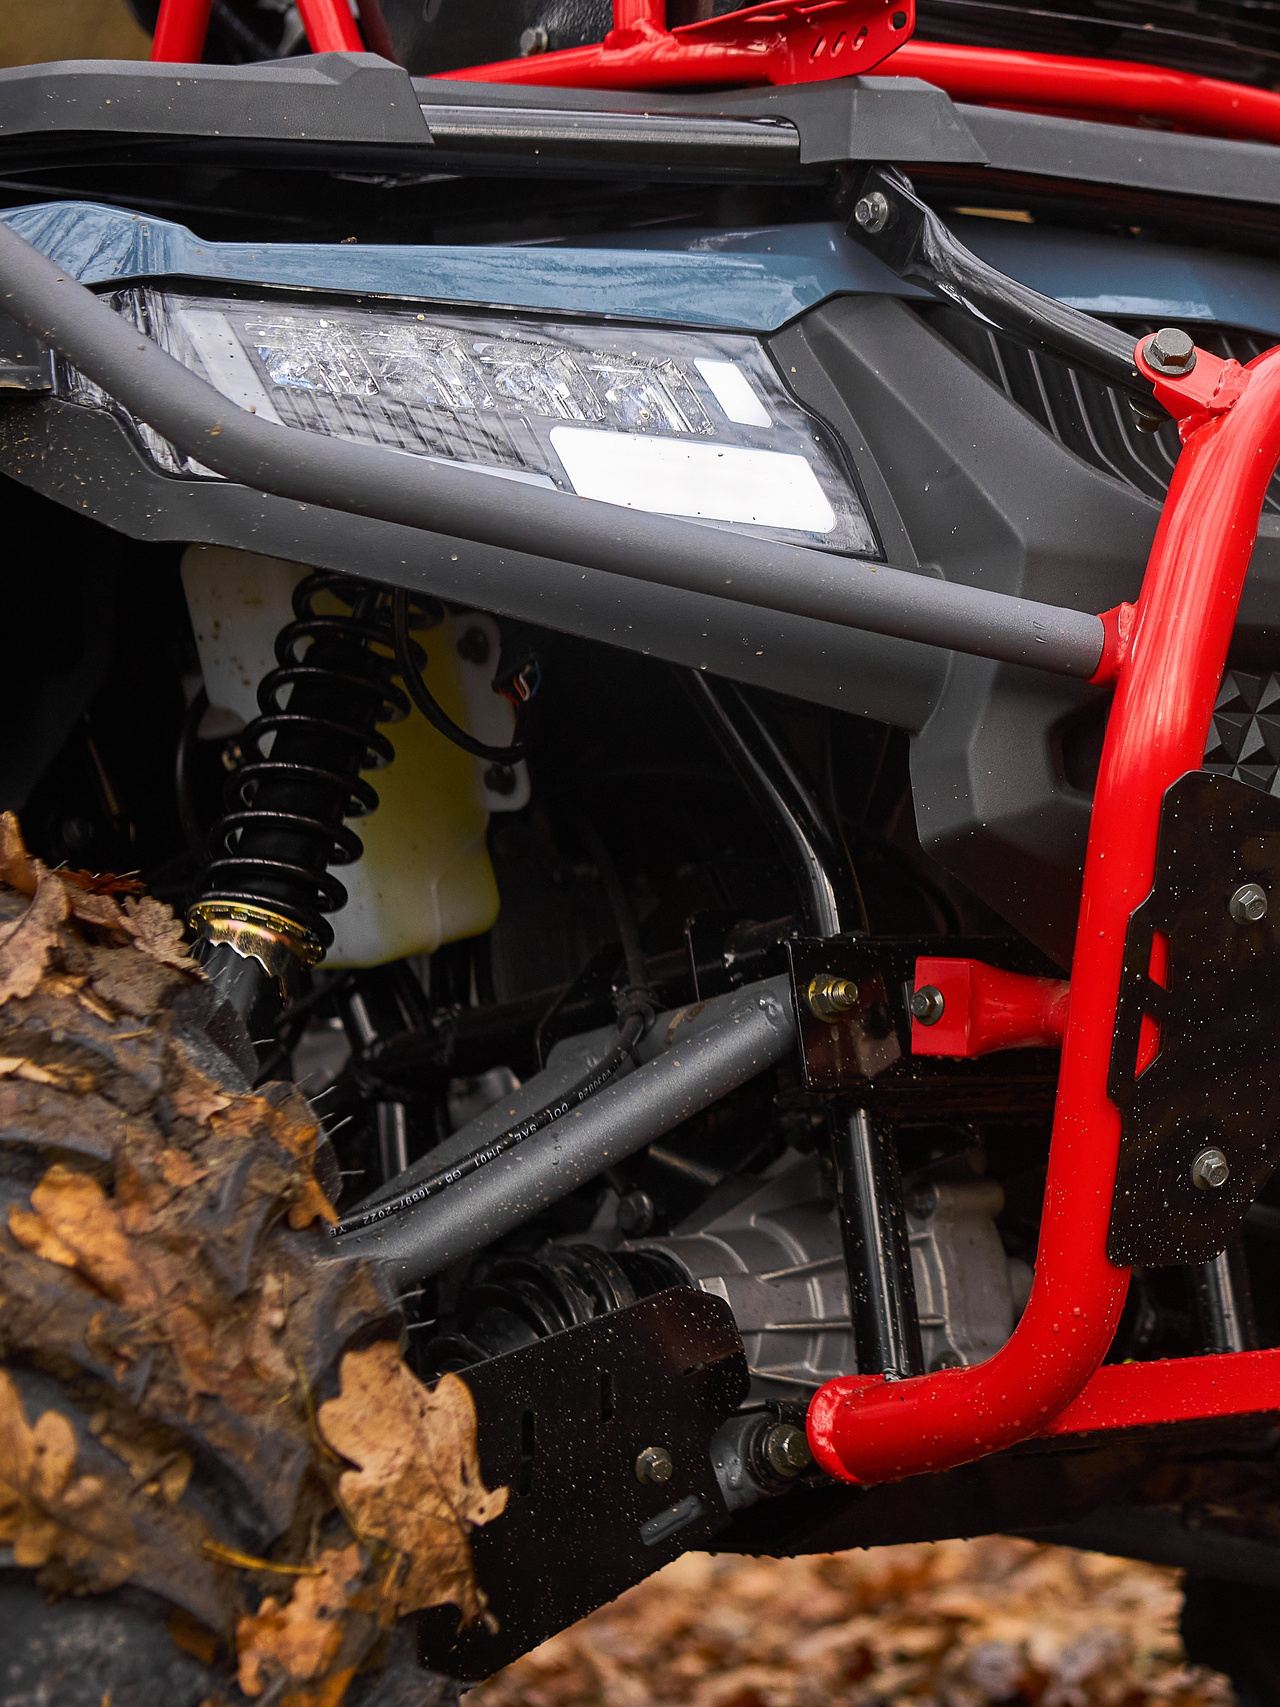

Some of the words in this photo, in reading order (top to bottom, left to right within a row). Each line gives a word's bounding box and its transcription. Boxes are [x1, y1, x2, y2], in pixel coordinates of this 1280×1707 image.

[514, 1124, 537, 1143] SAE
[474, 1145, 503, 1167] J1401
[445, 1170, 462, 1184] GB
[362, 1187, 431, 1225] 16897-2022
